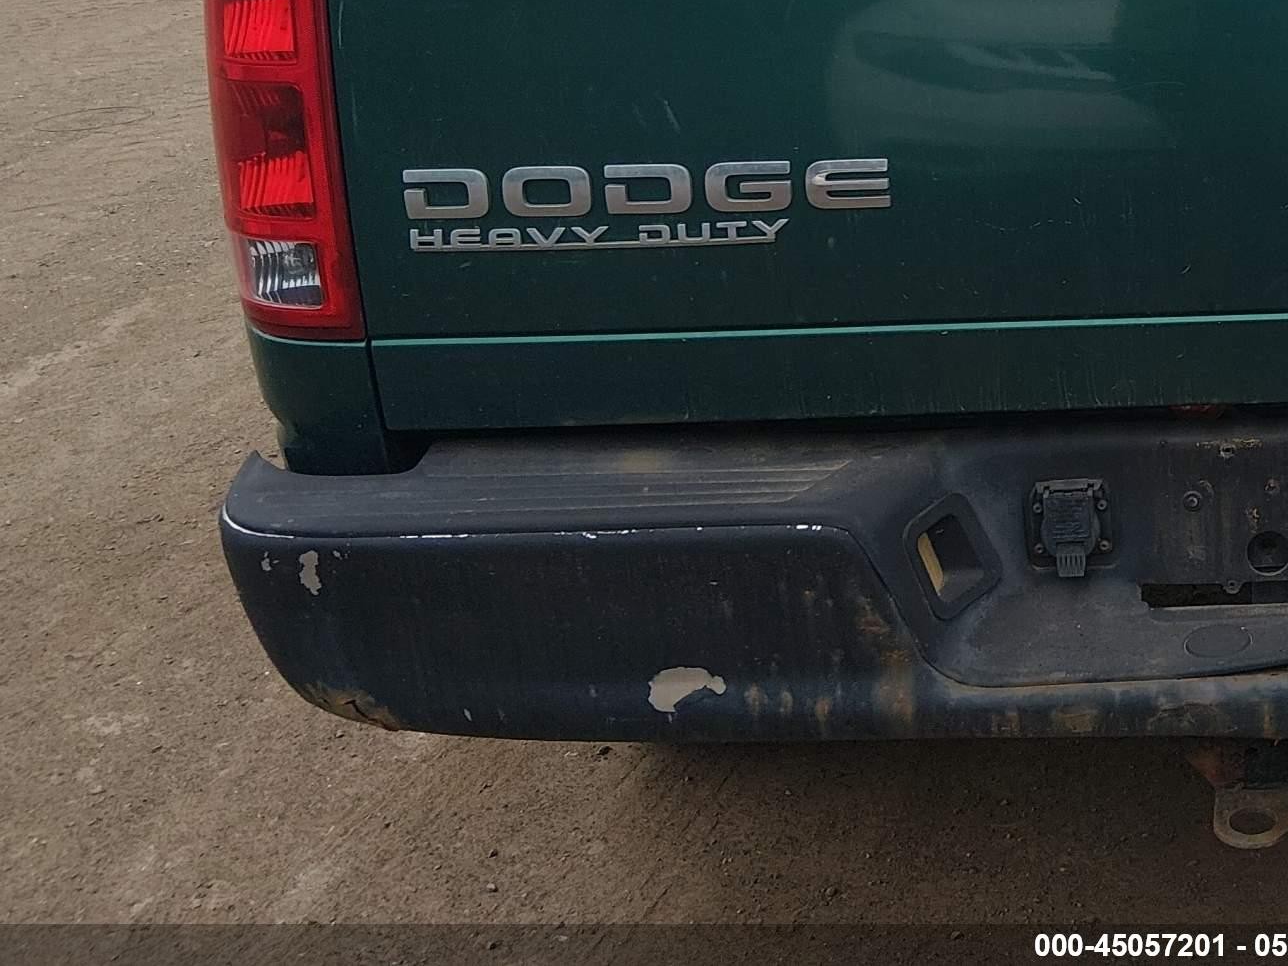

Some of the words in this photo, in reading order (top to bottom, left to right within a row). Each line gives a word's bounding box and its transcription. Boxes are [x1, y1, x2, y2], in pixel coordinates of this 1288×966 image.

[402, 157, 892, 219] DODGE
[410, 225, 609, 249] HEAVY
[638, 218, 790, 244] DUTY
